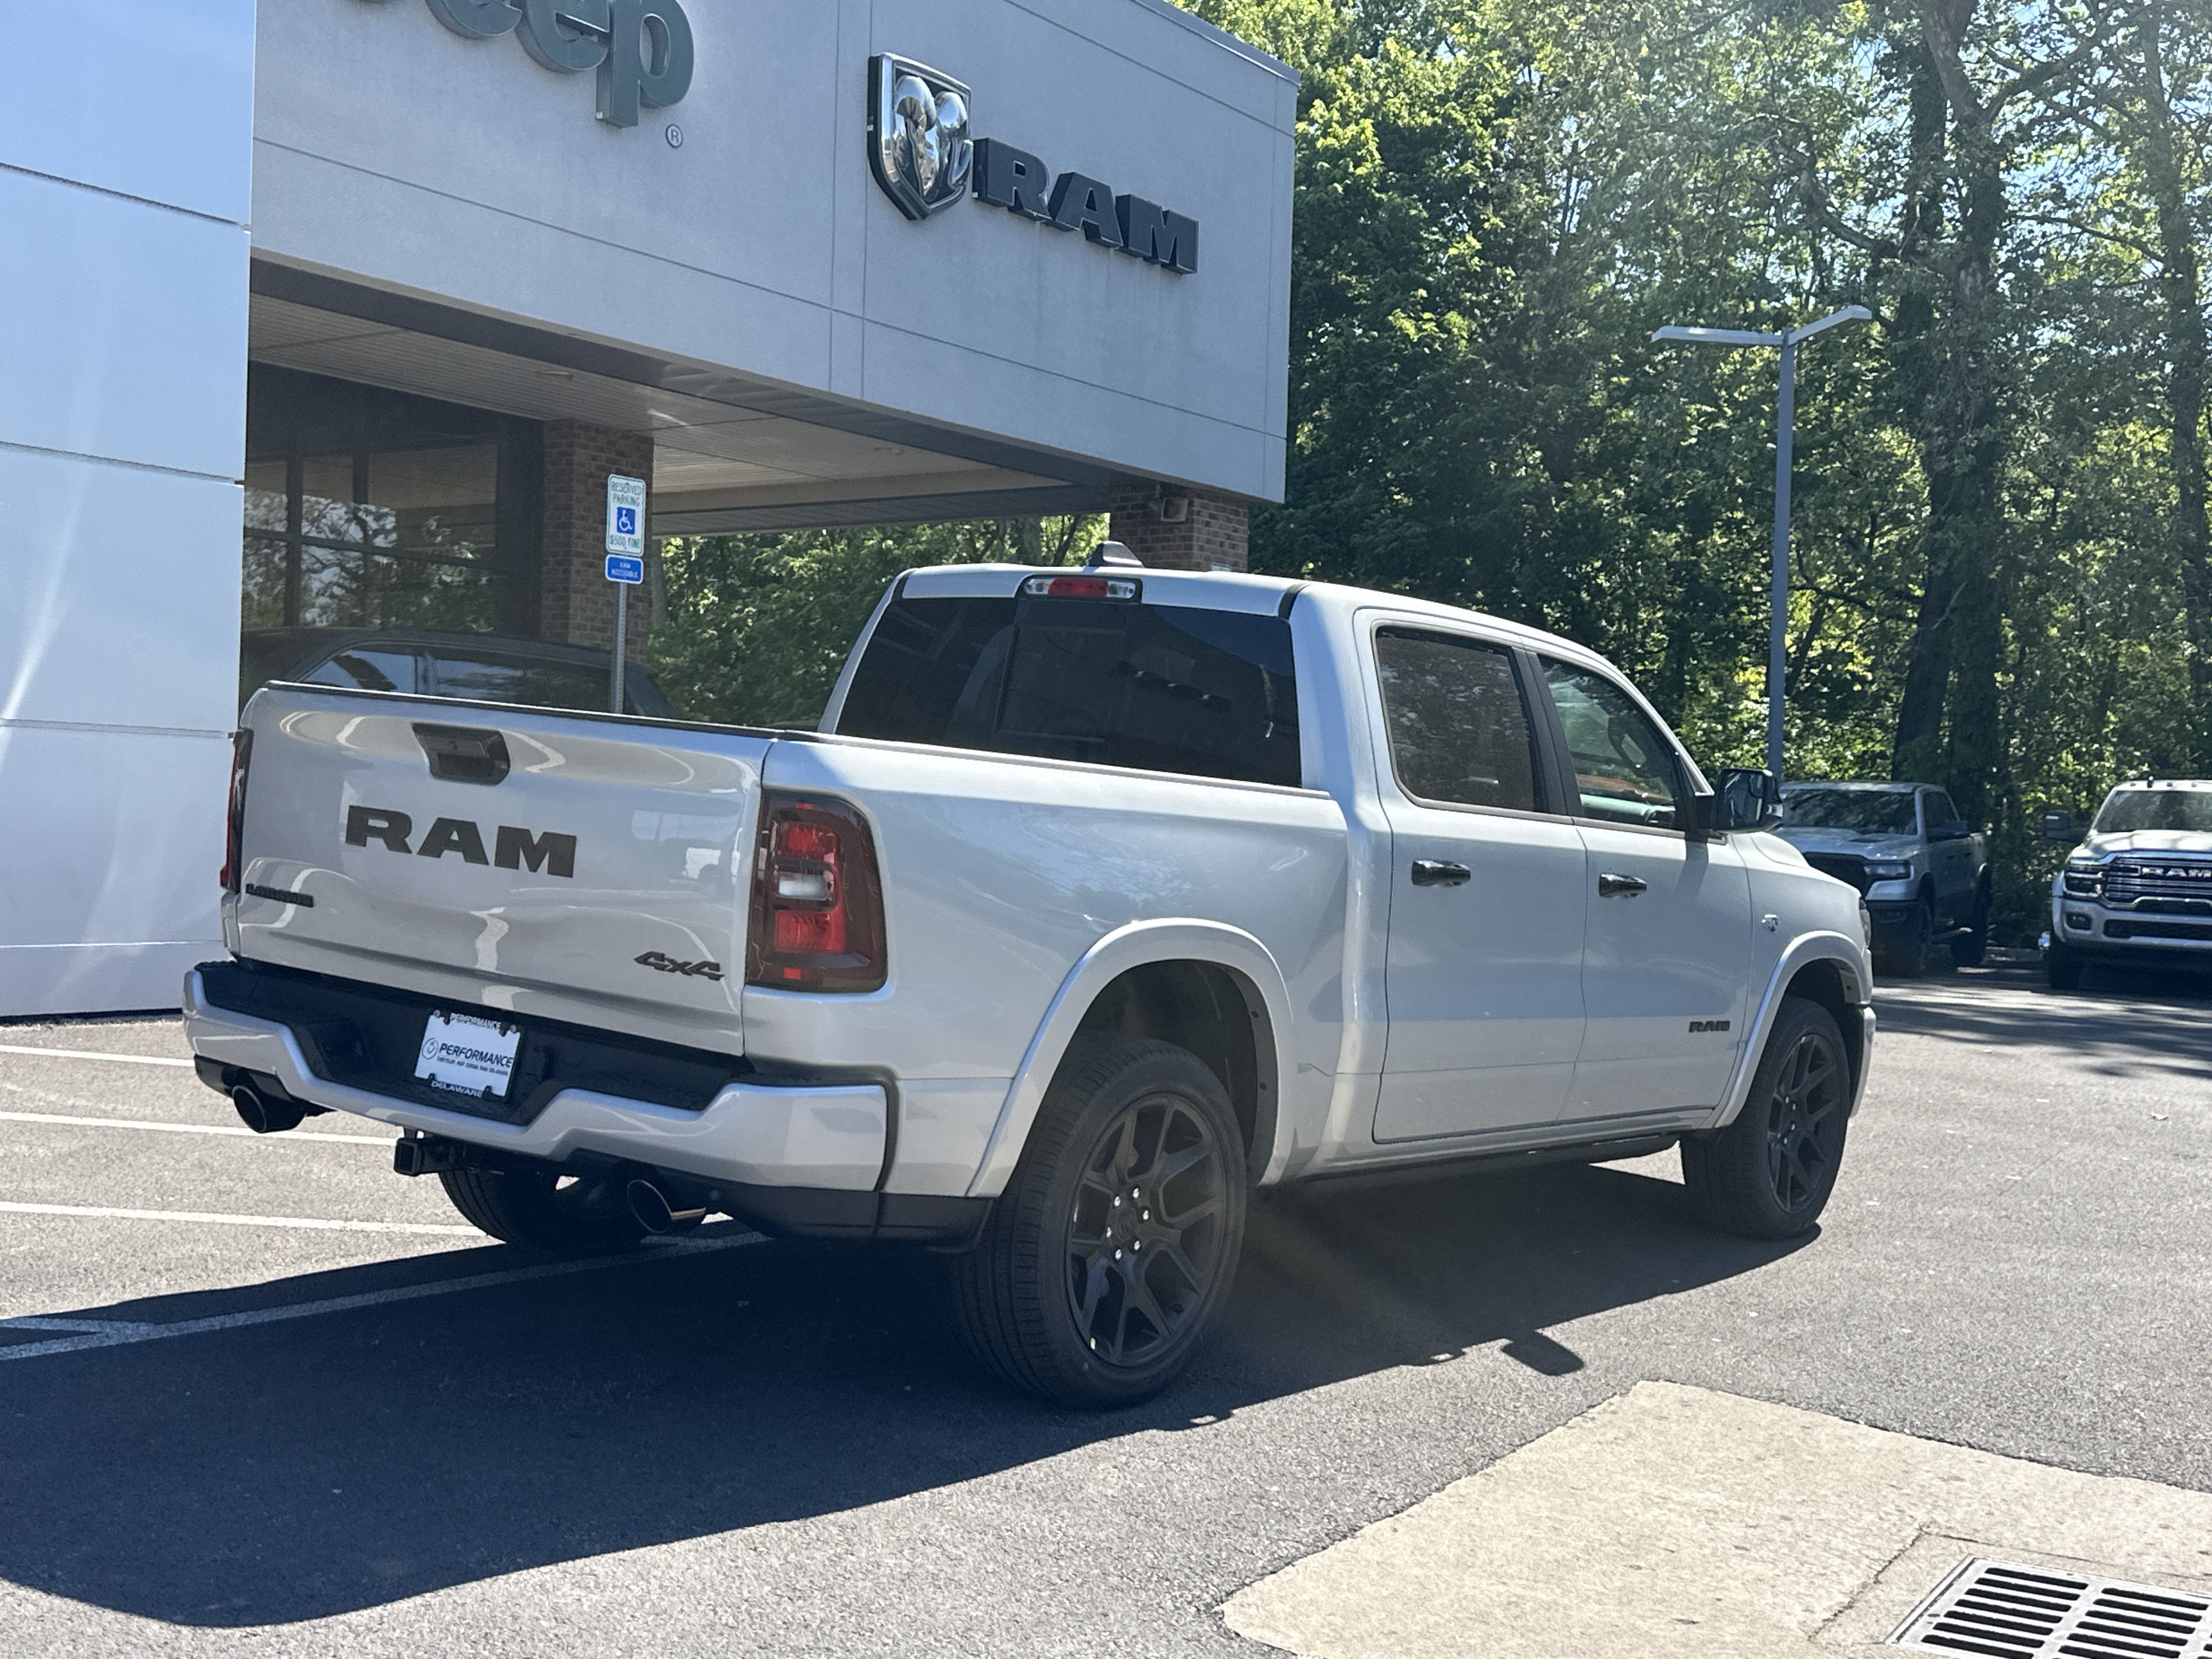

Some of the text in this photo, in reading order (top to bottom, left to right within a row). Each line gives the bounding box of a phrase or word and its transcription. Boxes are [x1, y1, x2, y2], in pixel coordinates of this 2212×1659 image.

[347, 0, 694, 128] ep
[973, 137, 1199, 274] RAM
[611, 482, 642, 495] RESERVED
[612, 493, 641, 507] PARKING
[345, 805, 577, 878] RAM
[2141, 867, 2211, 878] RAM
[450, 1012, 501, 1030] PERFORMANCE
[1689, 1020, 1730, 1033] RAM
[439, 1043, 514, 1068] PERFORMANCE
[431, 1080, 483, 1098] DELAWARE
